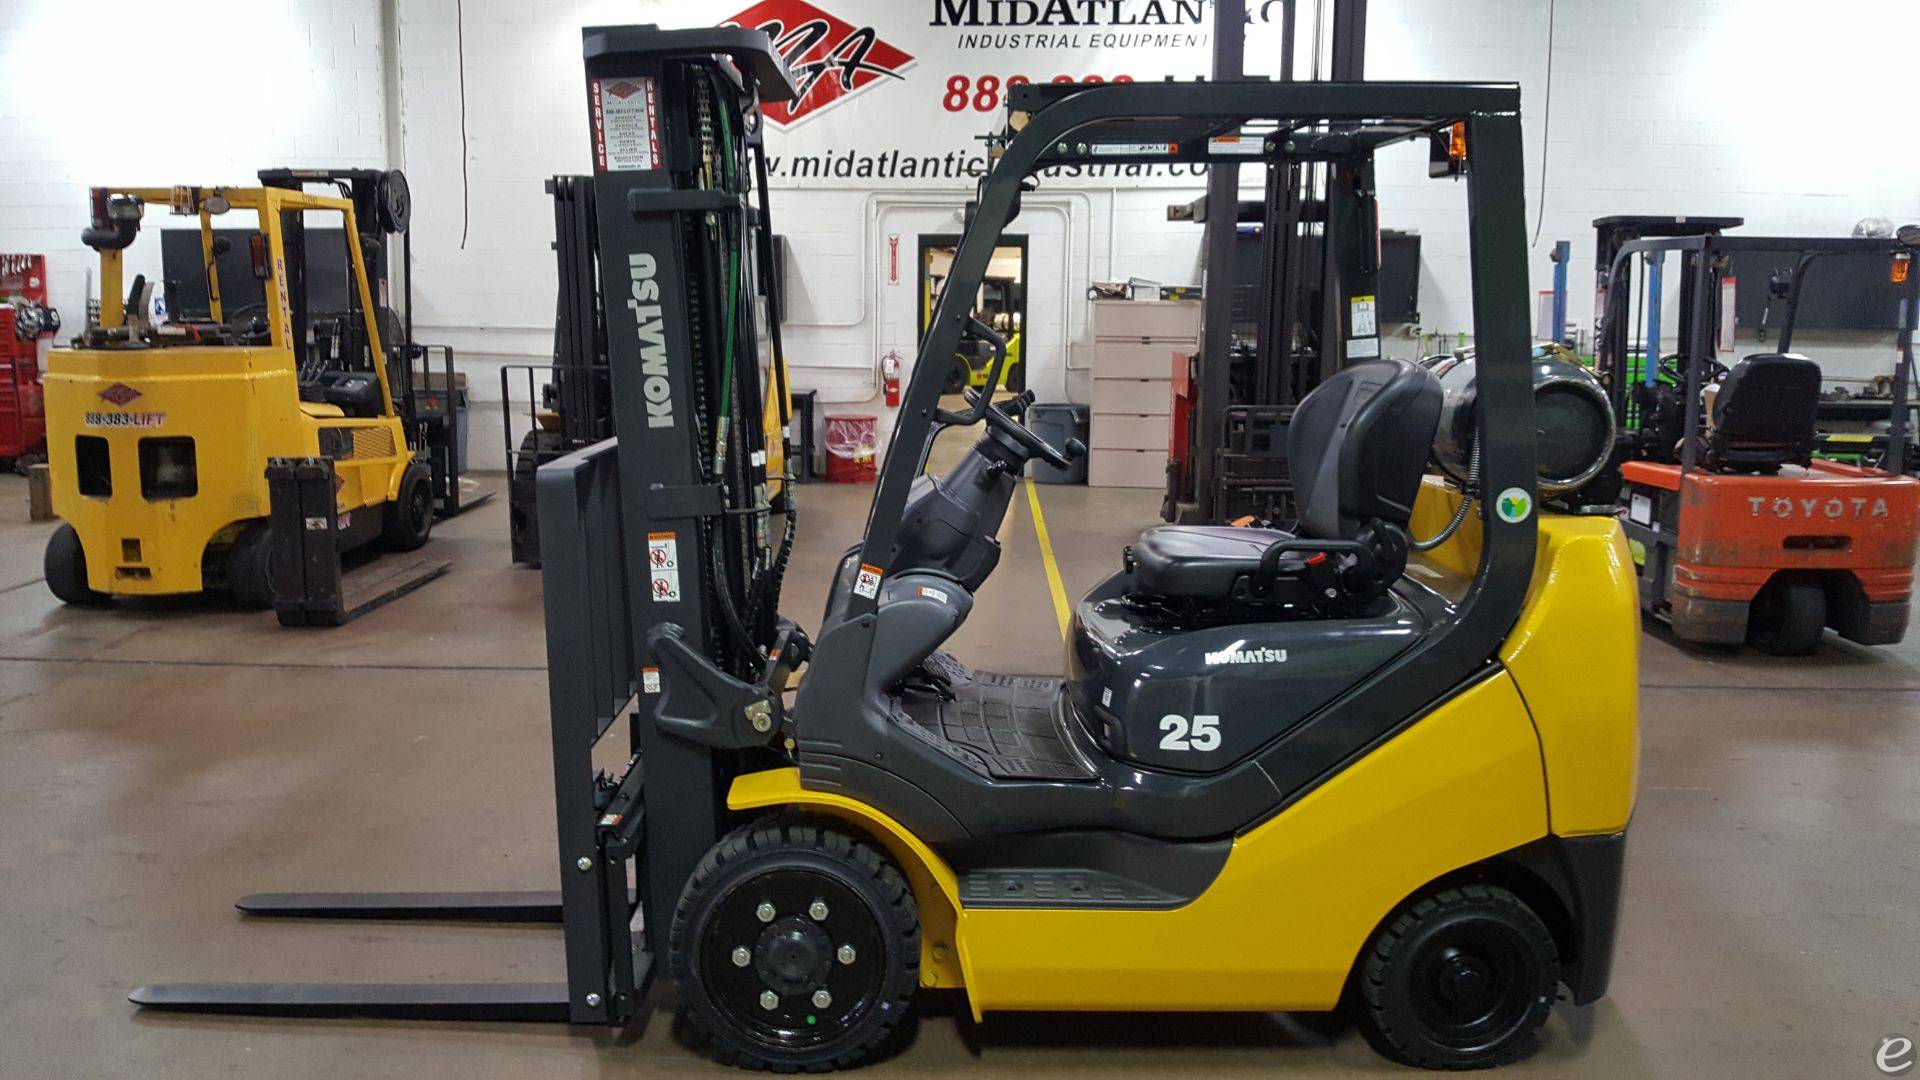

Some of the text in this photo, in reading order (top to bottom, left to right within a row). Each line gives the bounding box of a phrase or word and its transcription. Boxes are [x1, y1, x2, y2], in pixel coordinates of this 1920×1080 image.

[957, 34, 1082, 49] INDUSTRIAL
[593, 82, 606, 167] SERVICE
[646, 80, 659, 165] RENTALS
[277, 258, 292, 350] RENTAL
[627, 252, 674, 428] KOMATSU
[1747, 496, 1889, 519] TOYOTA
[1204, 647, 1288, 665] KOMATSU
[1158, 714, 1222, 751] 25
